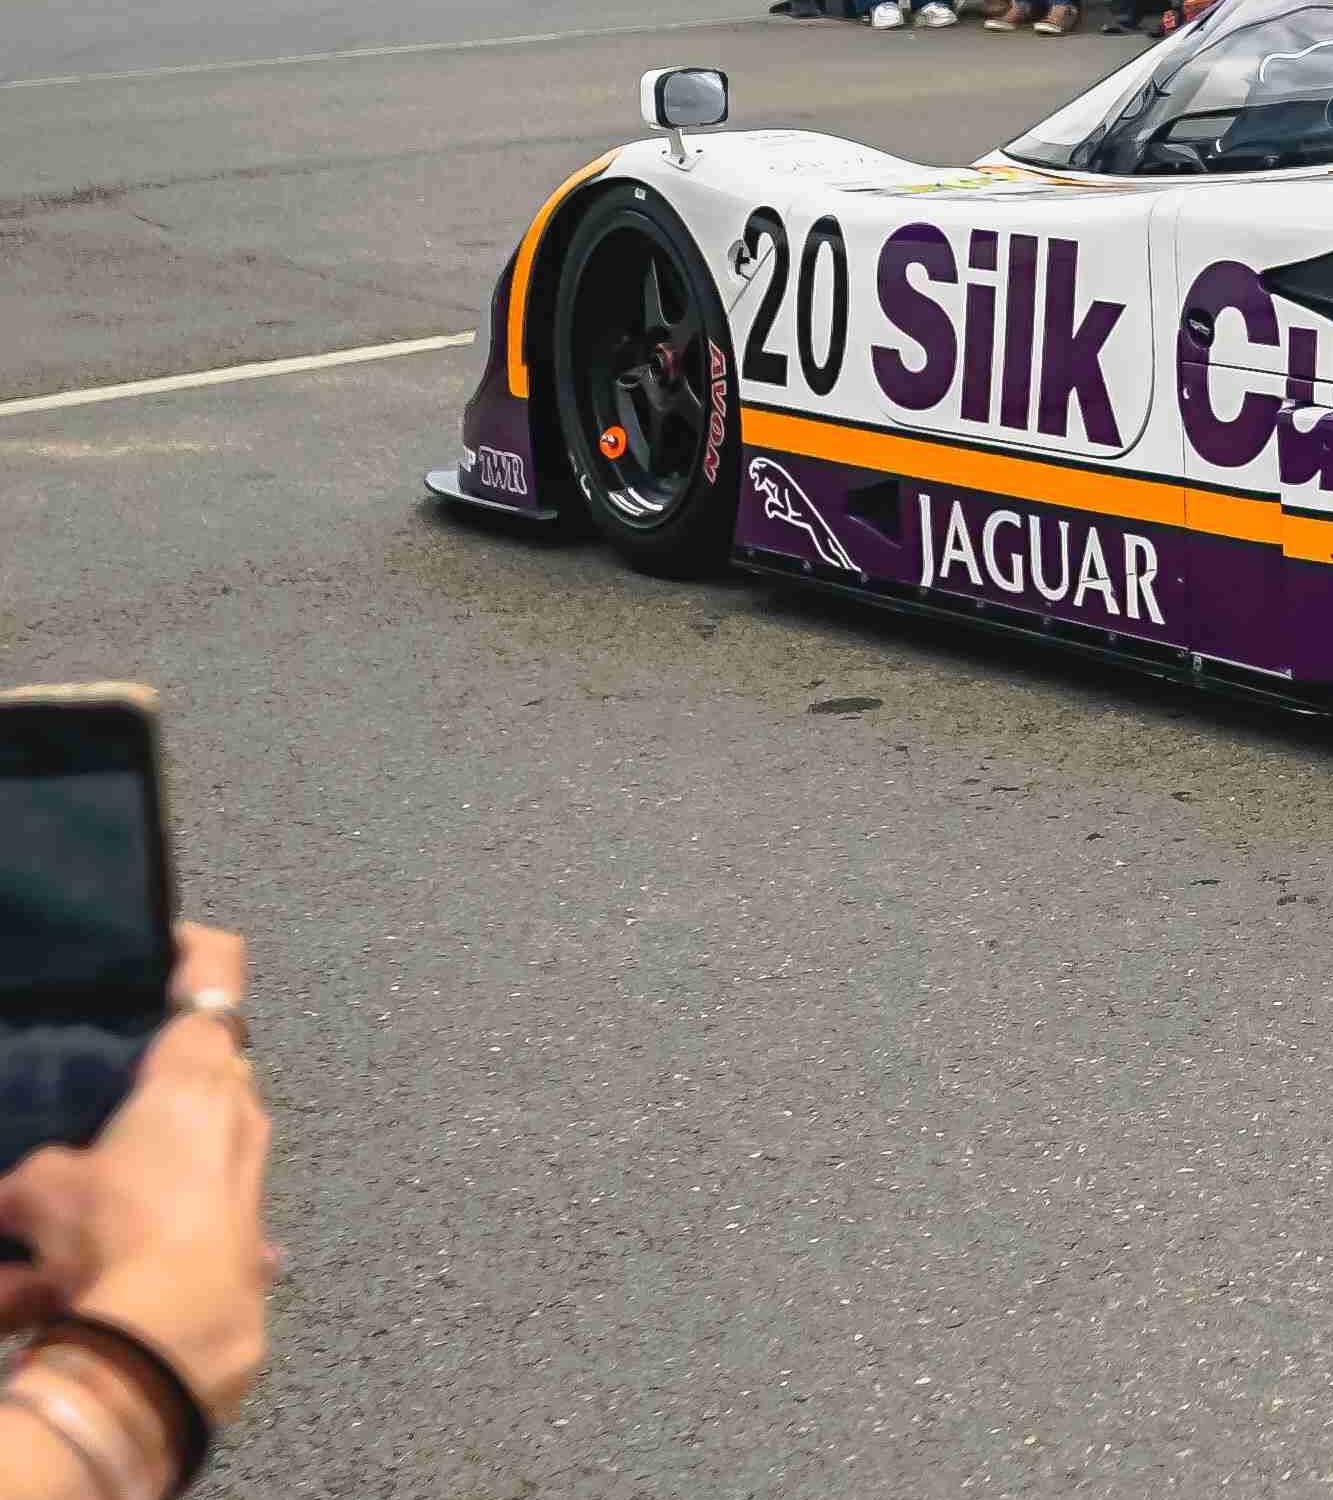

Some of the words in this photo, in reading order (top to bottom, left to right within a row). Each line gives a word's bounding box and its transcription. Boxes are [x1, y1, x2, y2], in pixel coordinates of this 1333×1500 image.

[741, 205, 848, 397] 20
[871, 222, 1126, 448] Silk
[479, 445, 528, 495] TWR
[702, 337, 727, 486] AVON
[919, 492, 1165, 625] JAGUAR
